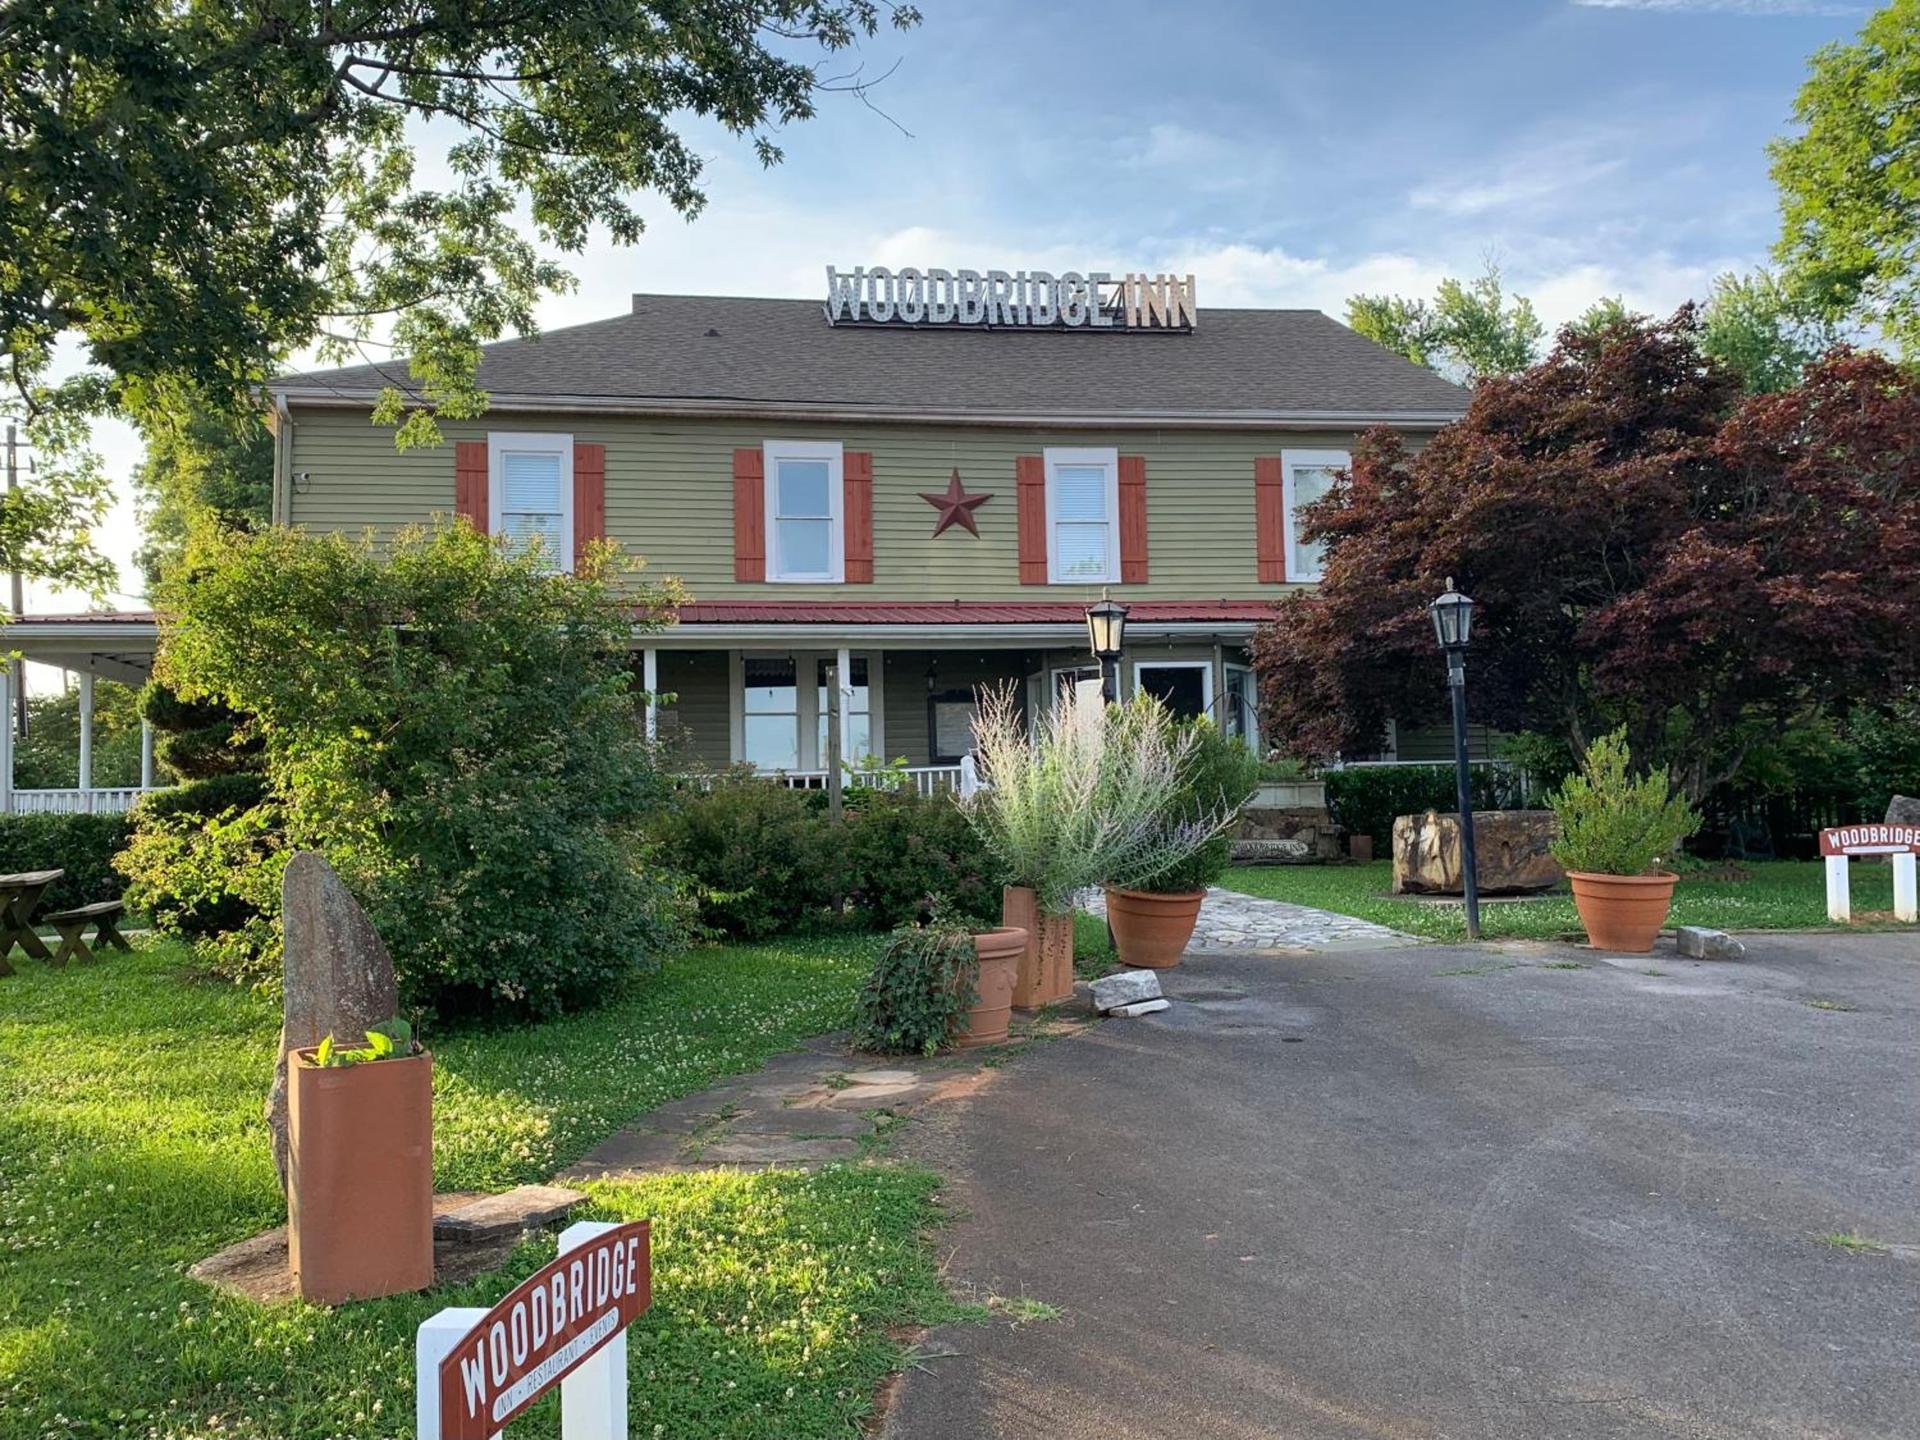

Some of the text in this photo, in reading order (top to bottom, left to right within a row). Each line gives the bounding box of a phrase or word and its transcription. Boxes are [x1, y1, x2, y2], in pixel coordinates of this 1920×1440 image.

[826, 265, 1197, 328] WOODBRIDGE INN
[1828, 827, 1920, 848] WOODBRIDGE
[460, 1237, 638, 1418] WOODBRIDGE
[497, 1311, 616, 1419] INN RESTAURANT EVENTS
